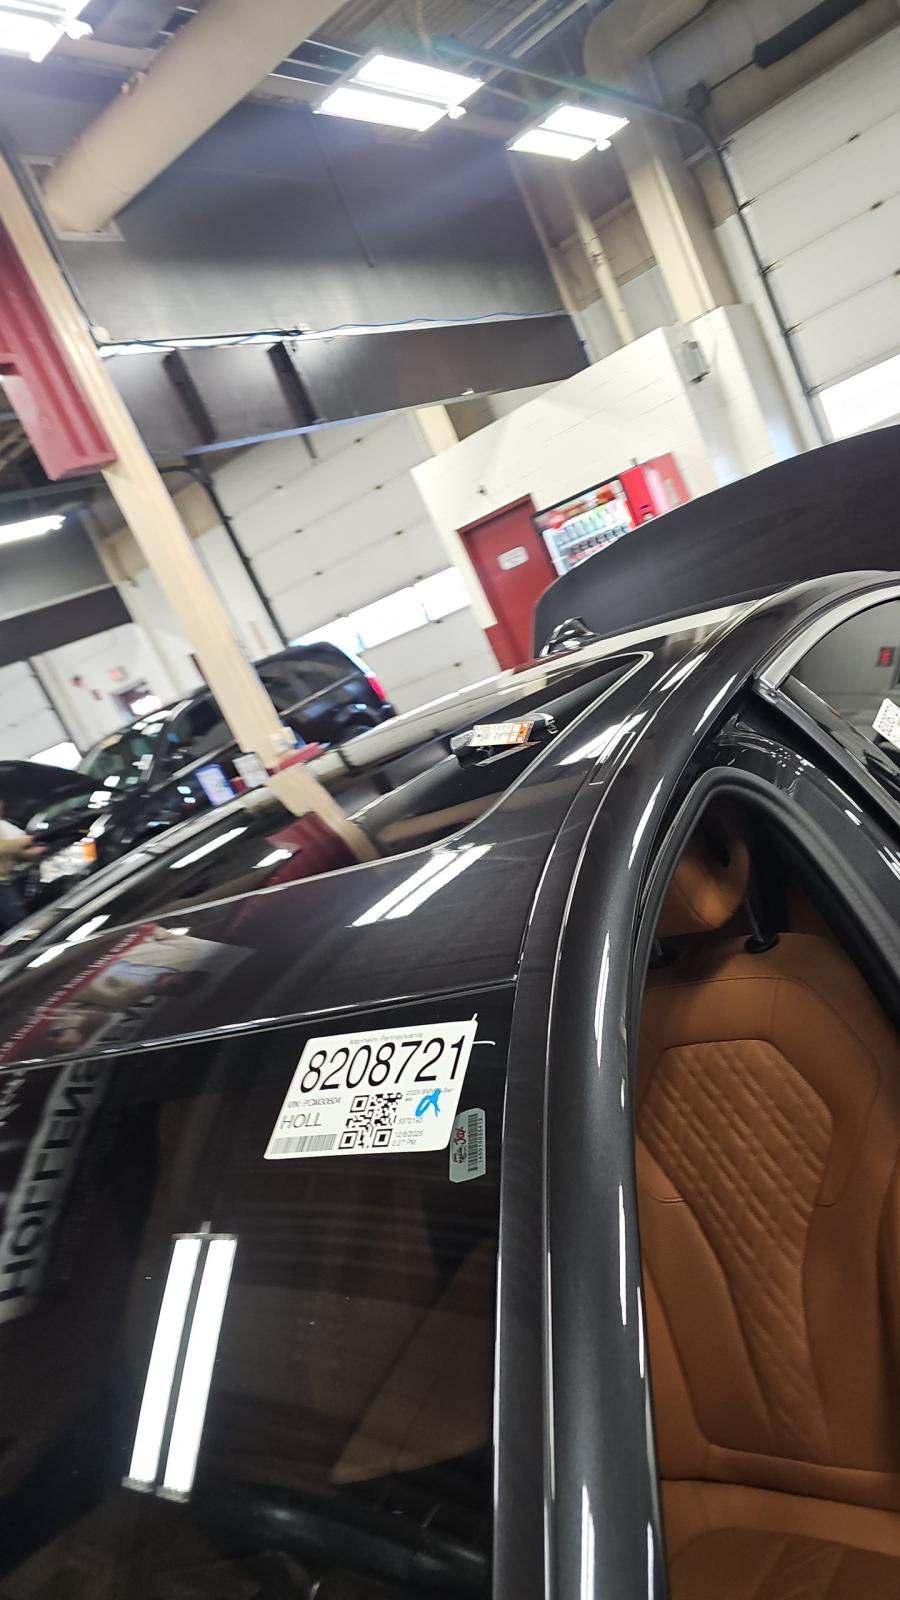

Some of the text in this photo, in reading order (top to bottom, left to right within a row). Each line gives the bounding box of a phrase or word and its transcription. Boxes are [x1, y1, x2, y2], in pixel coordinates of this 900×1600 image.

[380, 1031, 423, 1042] Pennsylvania
[300, 1035, 465, 1093] 8208721
[280, 1112, 322, 1130] HOLL
